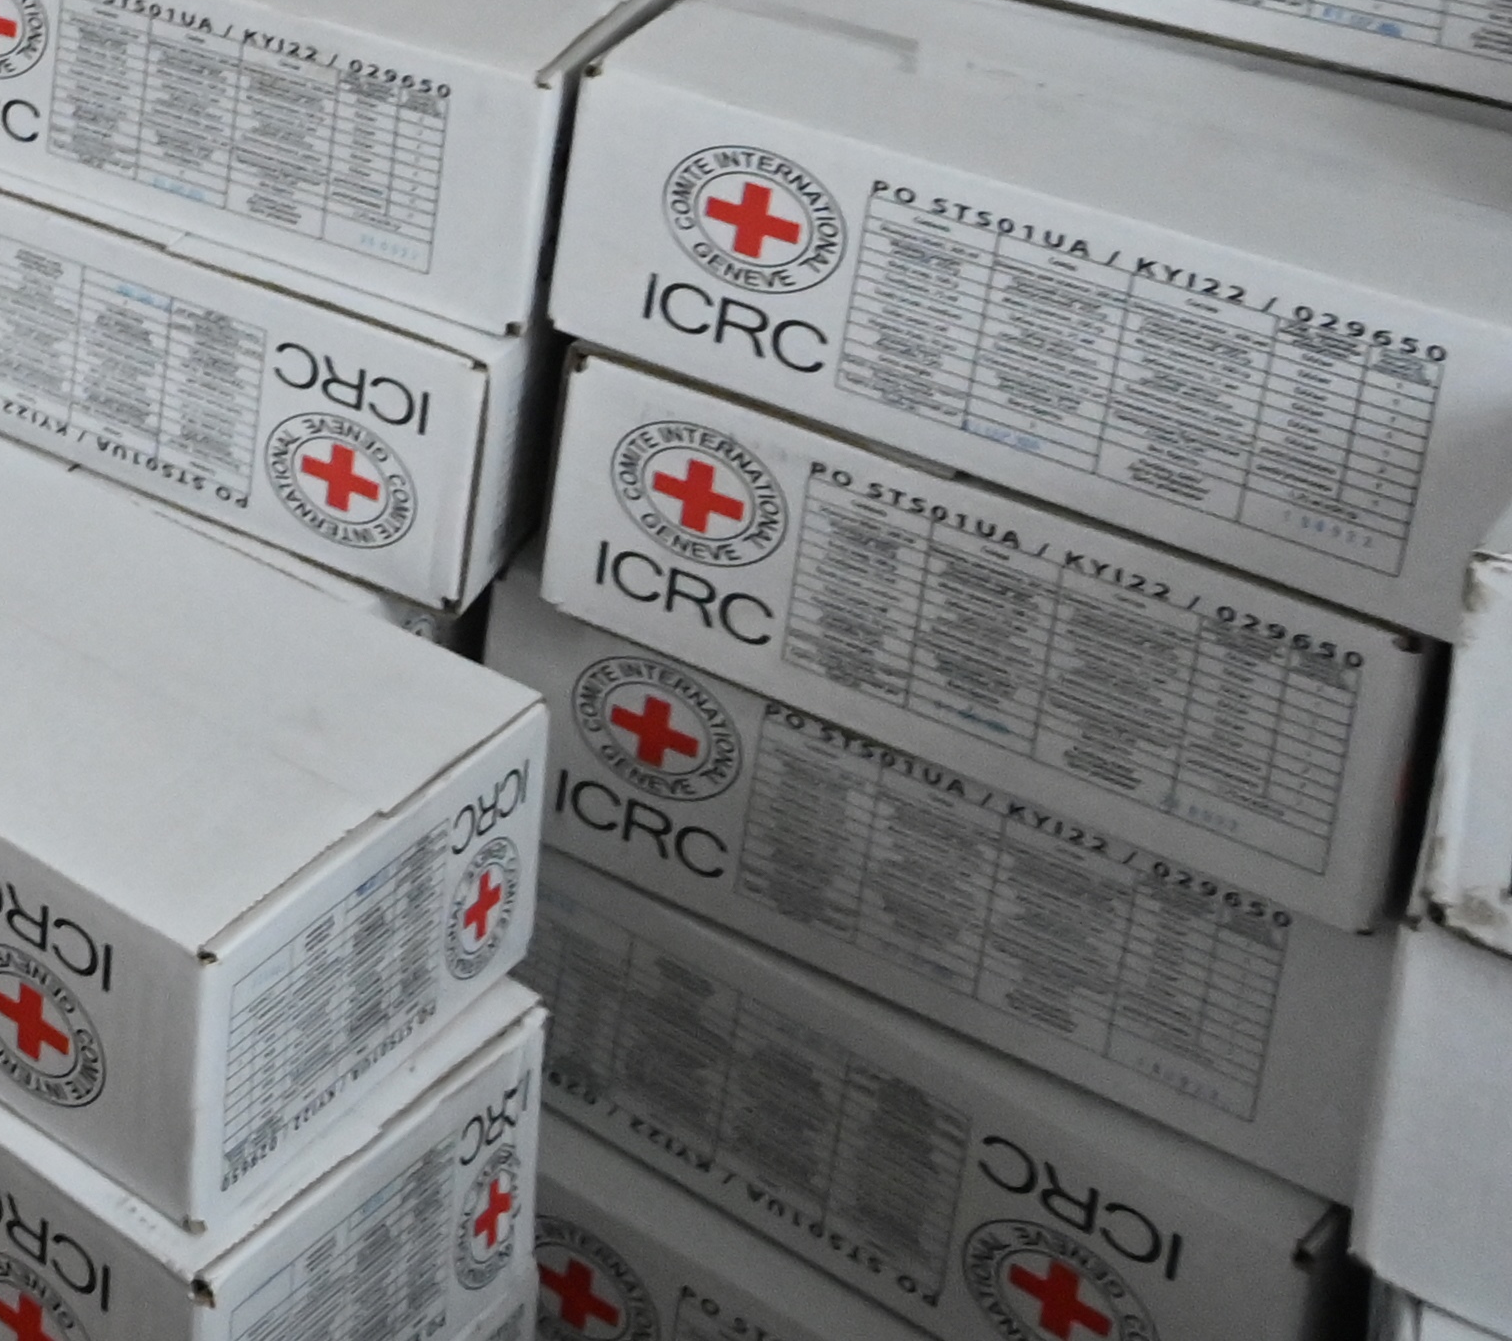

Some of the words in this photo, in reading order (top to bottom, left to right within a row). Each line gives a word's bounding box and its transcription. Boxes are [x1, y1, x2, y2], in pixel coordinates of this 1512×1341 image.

[712, 149, 843, 273] INTERNATIONAL
[692, 241, 797, 291] GENEVE
[870, 179, 915, 205] PO
[930, 197, 1091, 261] STS01UA
[1135, 257, 1246, 305] KYI22
[1293, 304, 1447, 363] 029650
[642, 272, 830, 374] ICRC
[273, 341, 431, 437] ICRC
[639, 512, 745, 564] GENEVE
[810, 460, 854, 488] PO
[865, 482, 1021, 550] STS01UA
[595, 541, 775, 647] ICRC
[451, 759, 531, 856] ICRC
[554, 768, 730, 880] ICRC
[978, 1134, 1183, 1282] ICRC
